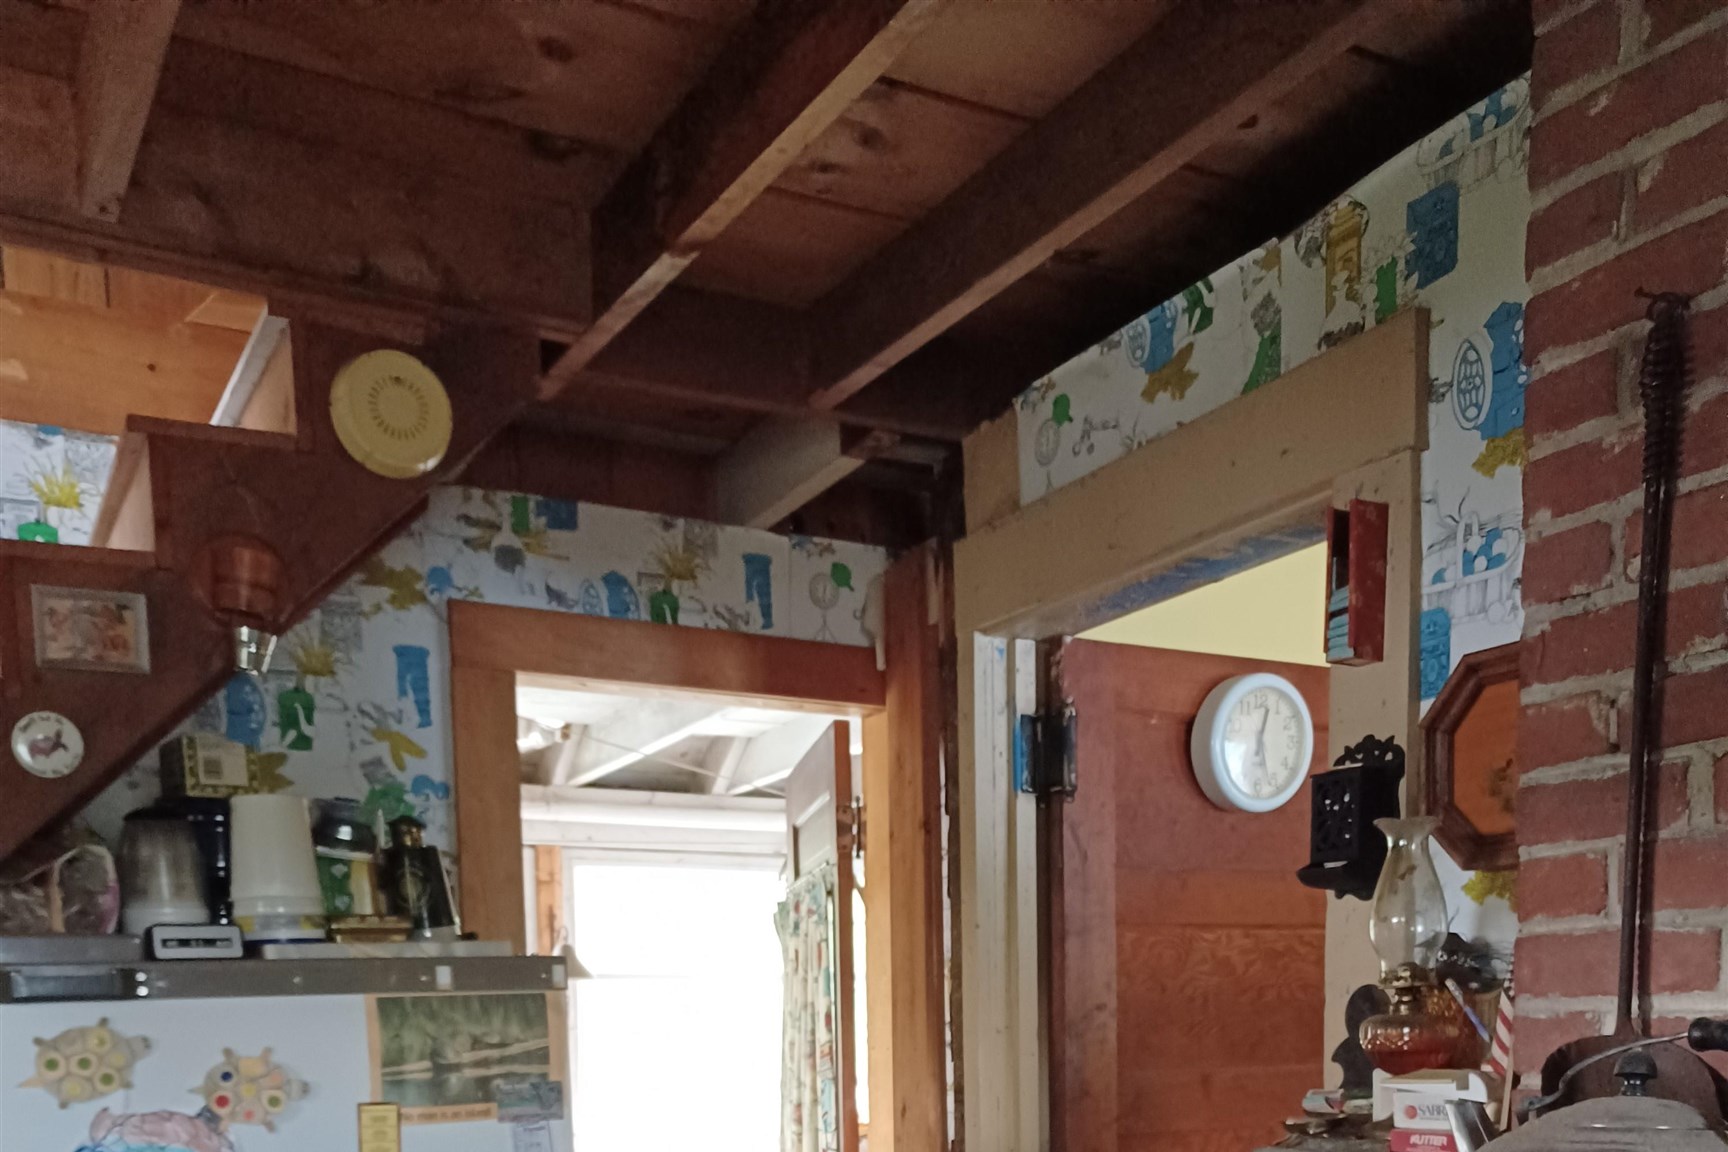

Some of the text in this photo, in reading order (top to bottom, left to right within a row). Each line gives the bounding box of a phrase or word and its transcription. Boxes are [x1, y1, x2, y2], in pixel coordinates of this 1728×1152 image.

[1240, 700, 1251, 716] 11
[1254, 695, 1268, 710] 12
[1283, 717, 1293, 731] 2
[1281, 757, 1289, 770] 4
[1418, 1103, 1449, 1117] SABR
